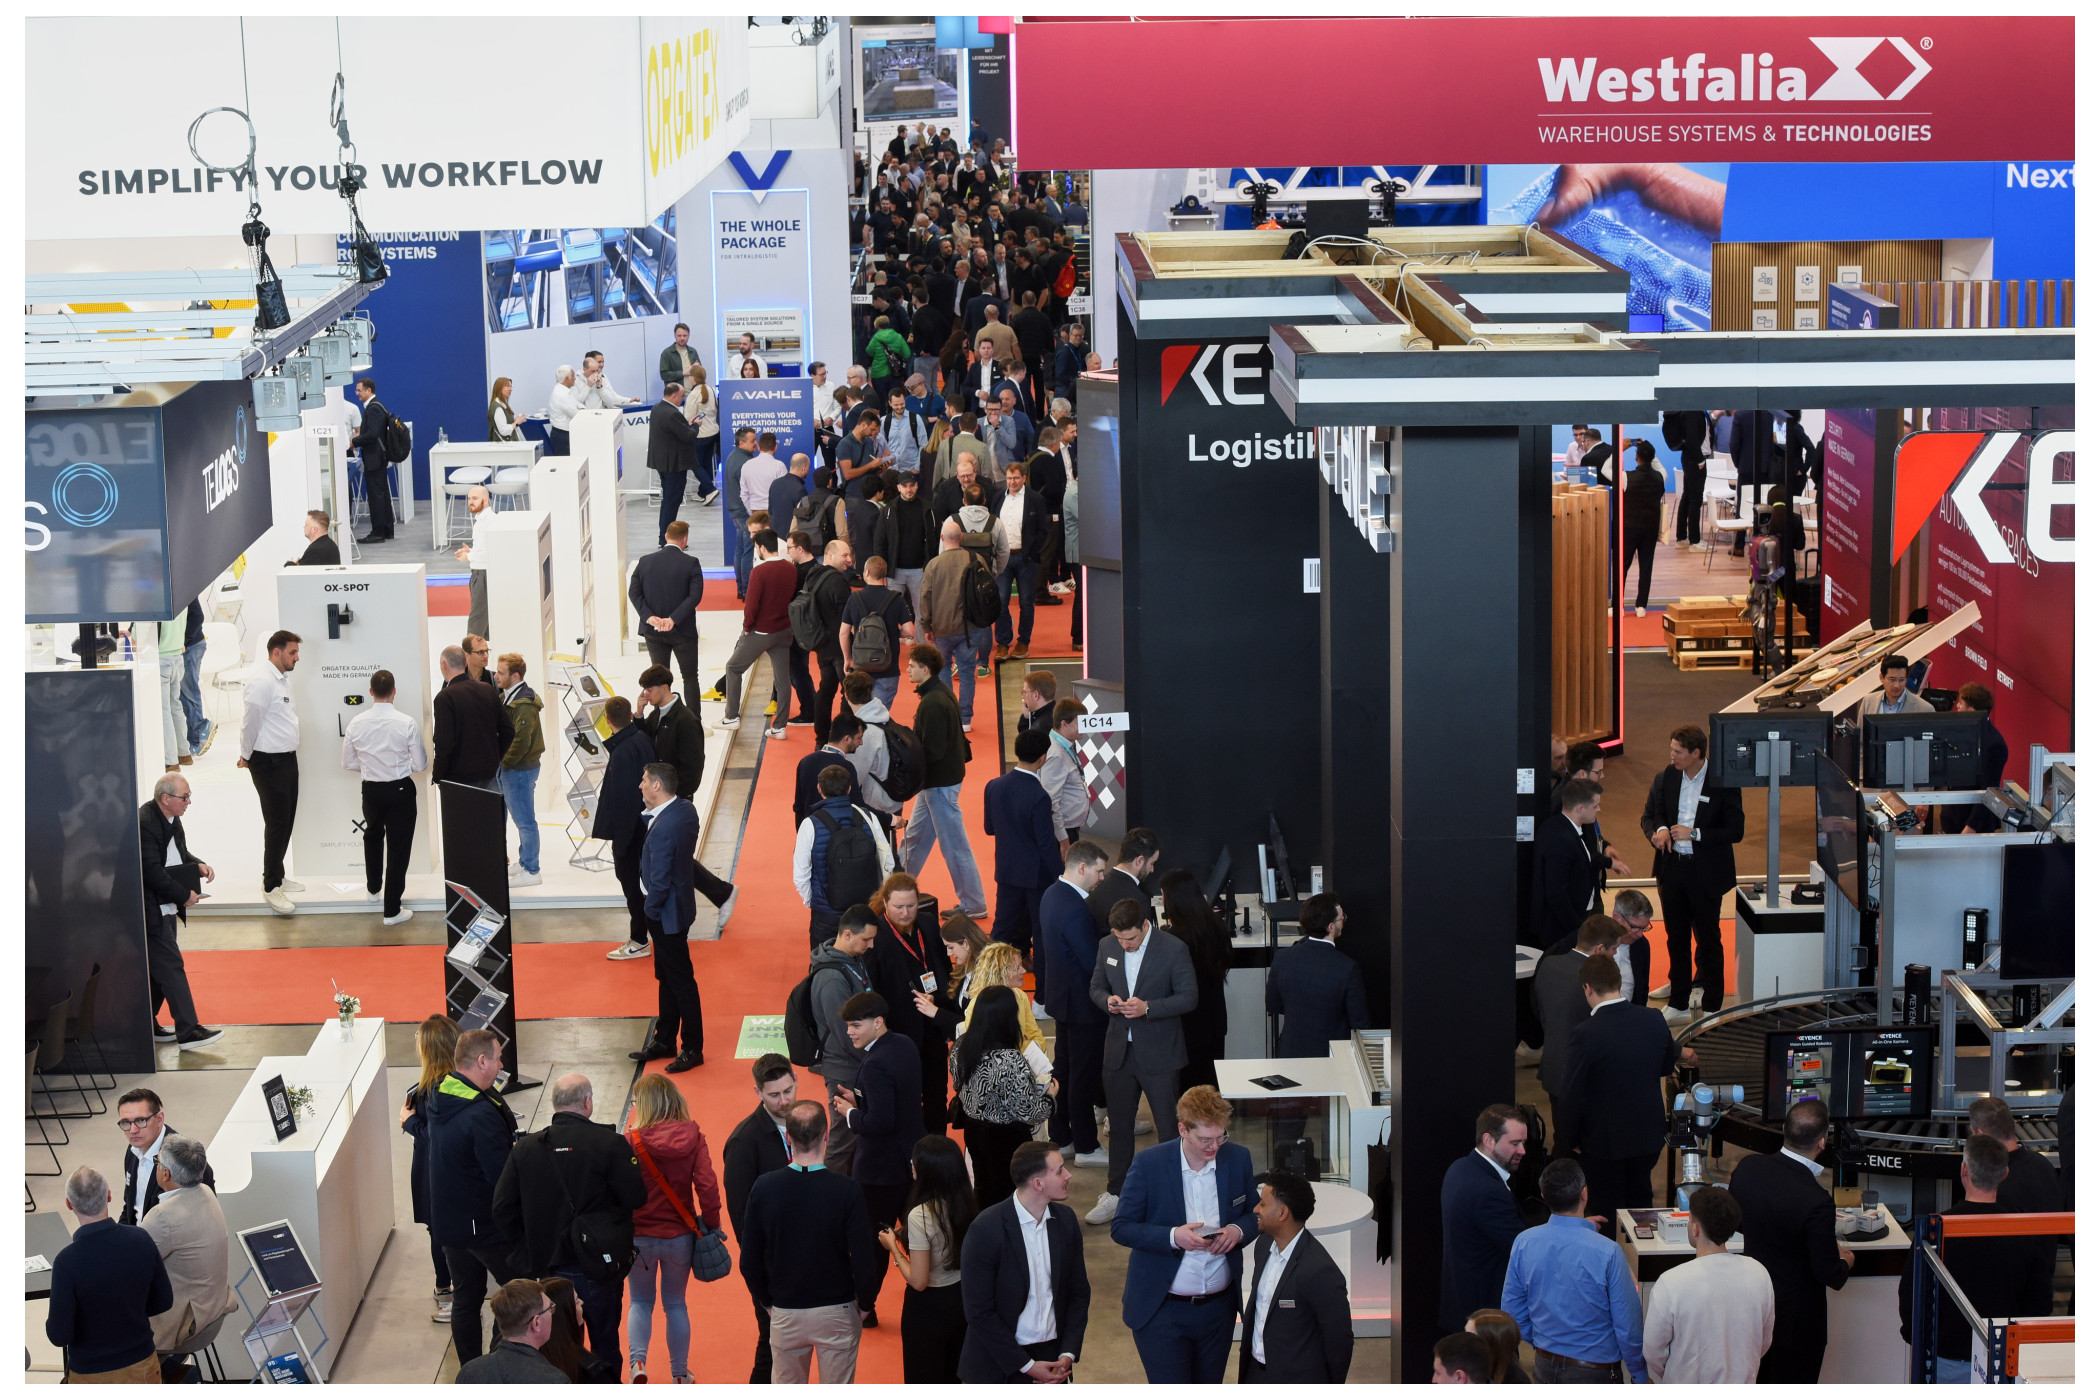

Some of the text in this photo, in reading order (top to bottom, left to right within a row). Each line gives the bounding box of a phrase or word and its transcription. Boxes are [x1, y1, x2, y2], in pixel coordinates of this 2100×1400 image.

[1537, 52, 1807, 102] Westfalia
[647, 24, 719, 178] ORGATEX
[1537, 124, 1933, 143] WAREHOUSE SYSTEMS & TECHNOLOGIES
[78, 158, 603, 196] SIMPLIFY YOUR WORKFLOW
[719, 219, 801, 233] THE WHOLE
[336, 230, 460, 243] COMUNICATION
[721, 236, 787, 249] PACKAGE
[379, 246, 437, 260] YSTEMS
[743, 390, 802, 400] VAHLE
[731, 411, 796, 420] EVERYTHING YOUR
[731, 418, 802, 427] APPLICATION NEEDS
[312, 427, 333, 435] 1C21
[202, 444, 239, 514] TELOGS
[324, 583, 370, 592] OX-SPOT
[1081, 716, 1113, 729] 1C14
